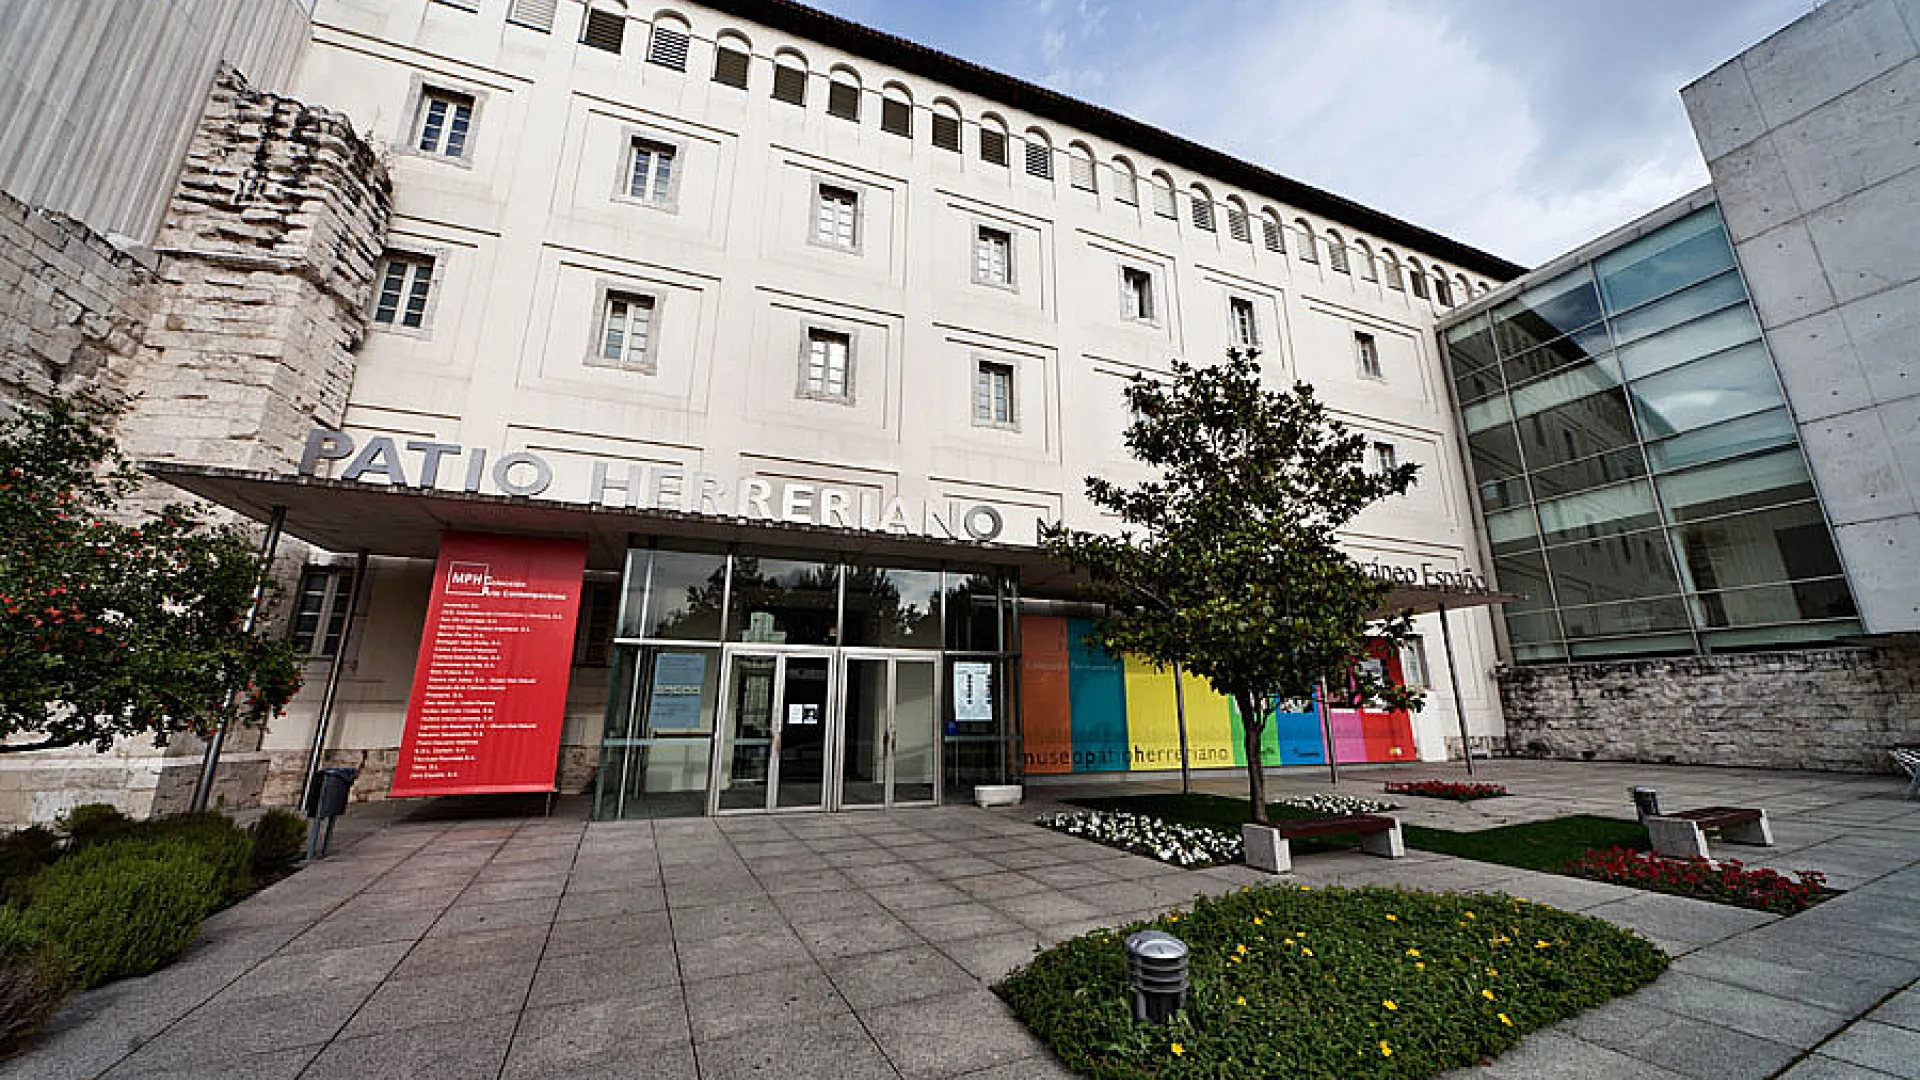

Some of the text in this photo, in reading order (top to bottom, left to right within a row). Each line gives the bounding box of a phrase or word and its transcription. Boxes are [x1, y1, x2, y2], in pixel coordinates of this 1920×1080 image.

[299, 428, 552, 496] PATIO
[590, 460, 1003, 542] HERRERIANO
[451, 572, 483, 586] MPH
